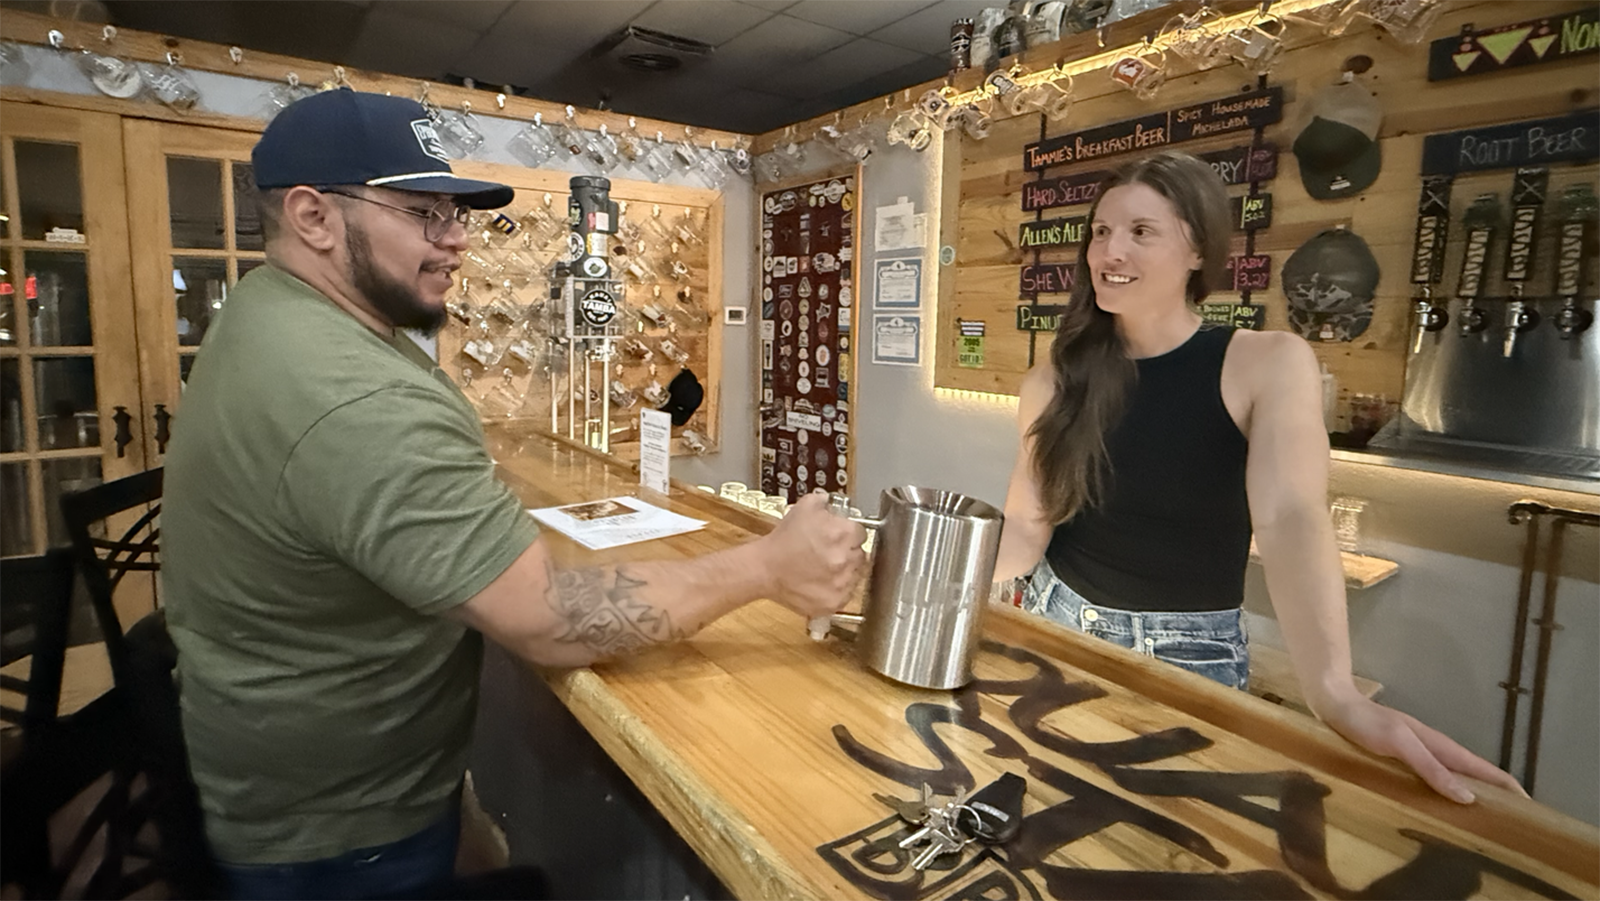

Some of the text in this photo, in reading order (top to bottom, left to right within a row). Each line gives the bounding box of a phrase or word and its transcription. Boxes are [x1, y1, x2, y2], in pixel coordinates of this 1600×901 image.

[1212, 97, 1271, 116] HOUSEMADE
[1192, 116, 1248, 136] MICHELADA
[1075, 135, 1134, 159] BREAKFAST
[1135, 124, 1164, 147] BEER
[1460, 126, 1586, 166] ROOT BEER
[1027, 186, 1057, 207] HARD
[1021, 224, 1061, 246] ALLEN'S
[1239, 257, 1267, 270] ABV
[1022, 265, 1054, 291] SHE
[1234, 306, 1258, 317] ABV
